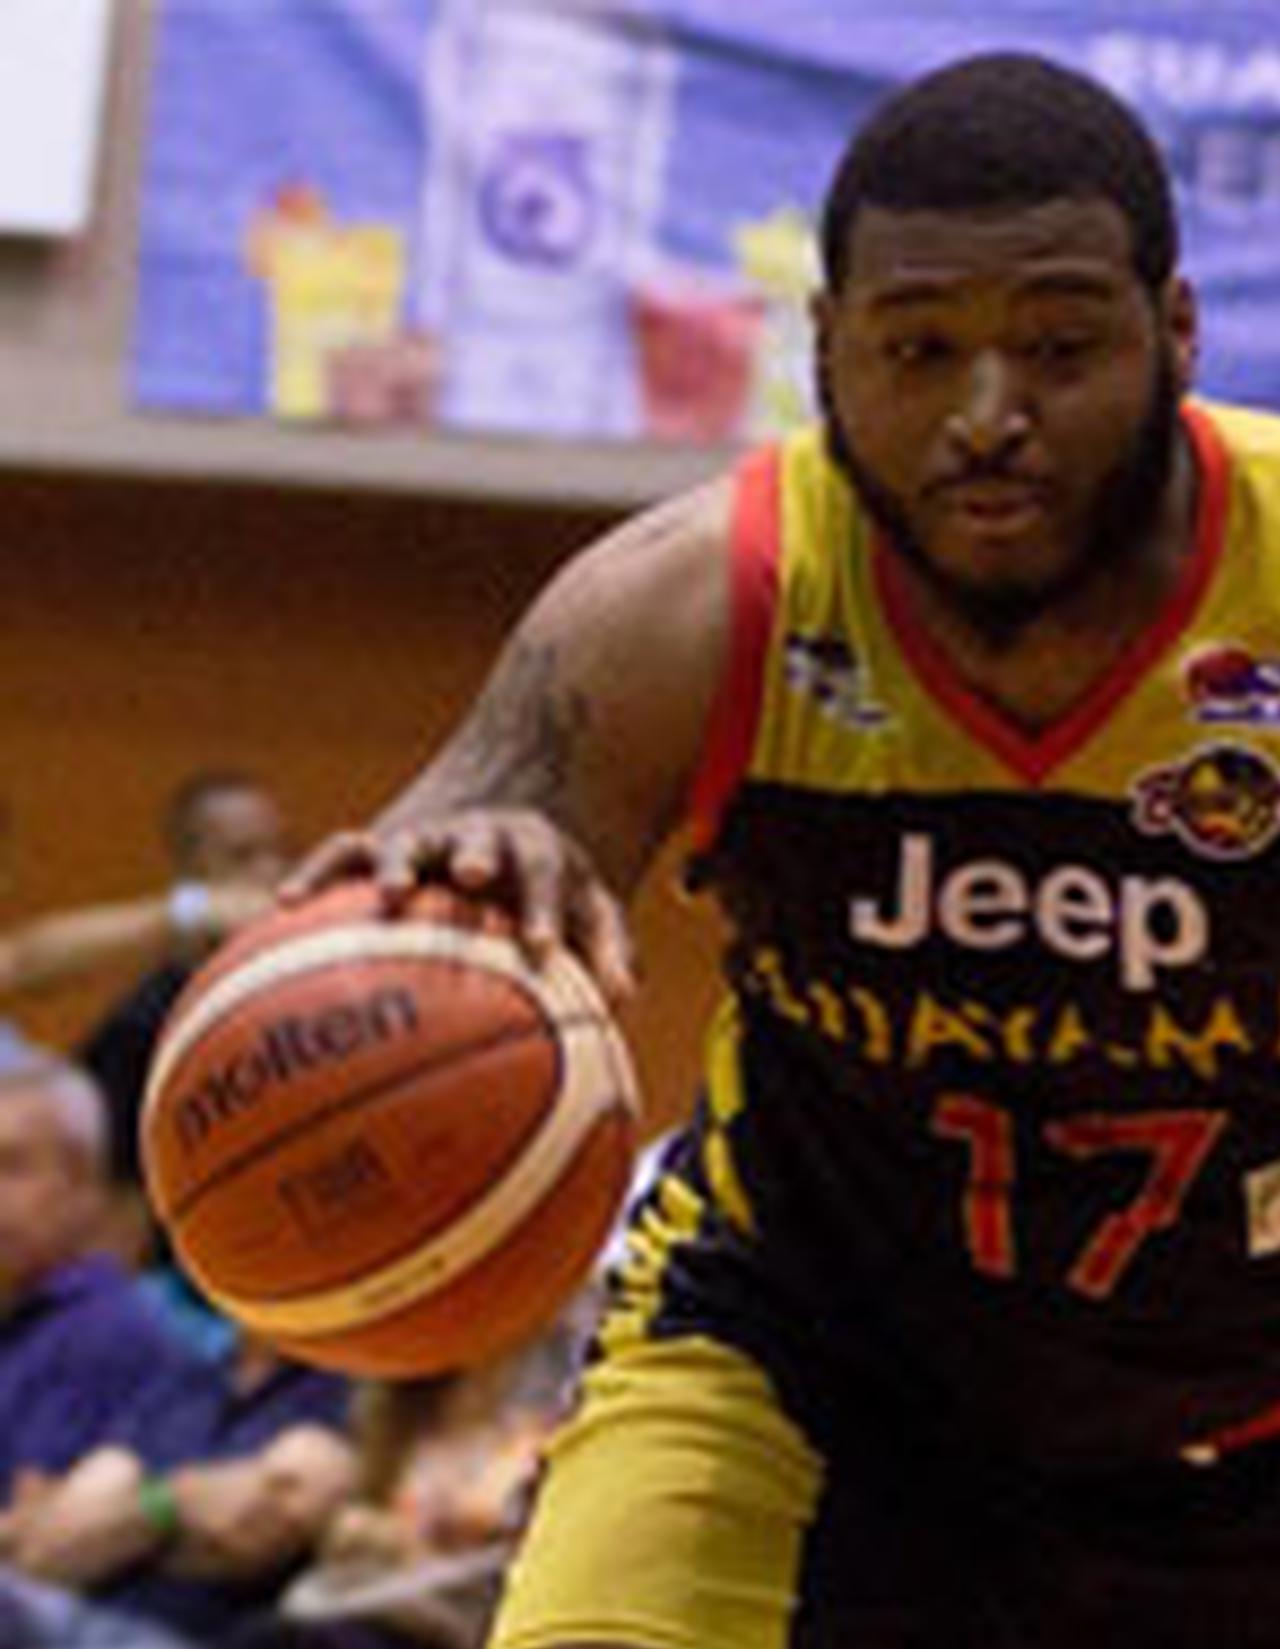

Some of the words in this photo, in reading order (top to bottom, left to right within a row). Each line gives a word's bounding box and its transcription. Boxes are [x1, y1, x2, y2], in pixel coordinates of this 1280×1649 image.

[848, 832, 1210, 992] Jeep
[174, 985, 420, 1156] molten
[928, 1092, 1230, 1300] 17
